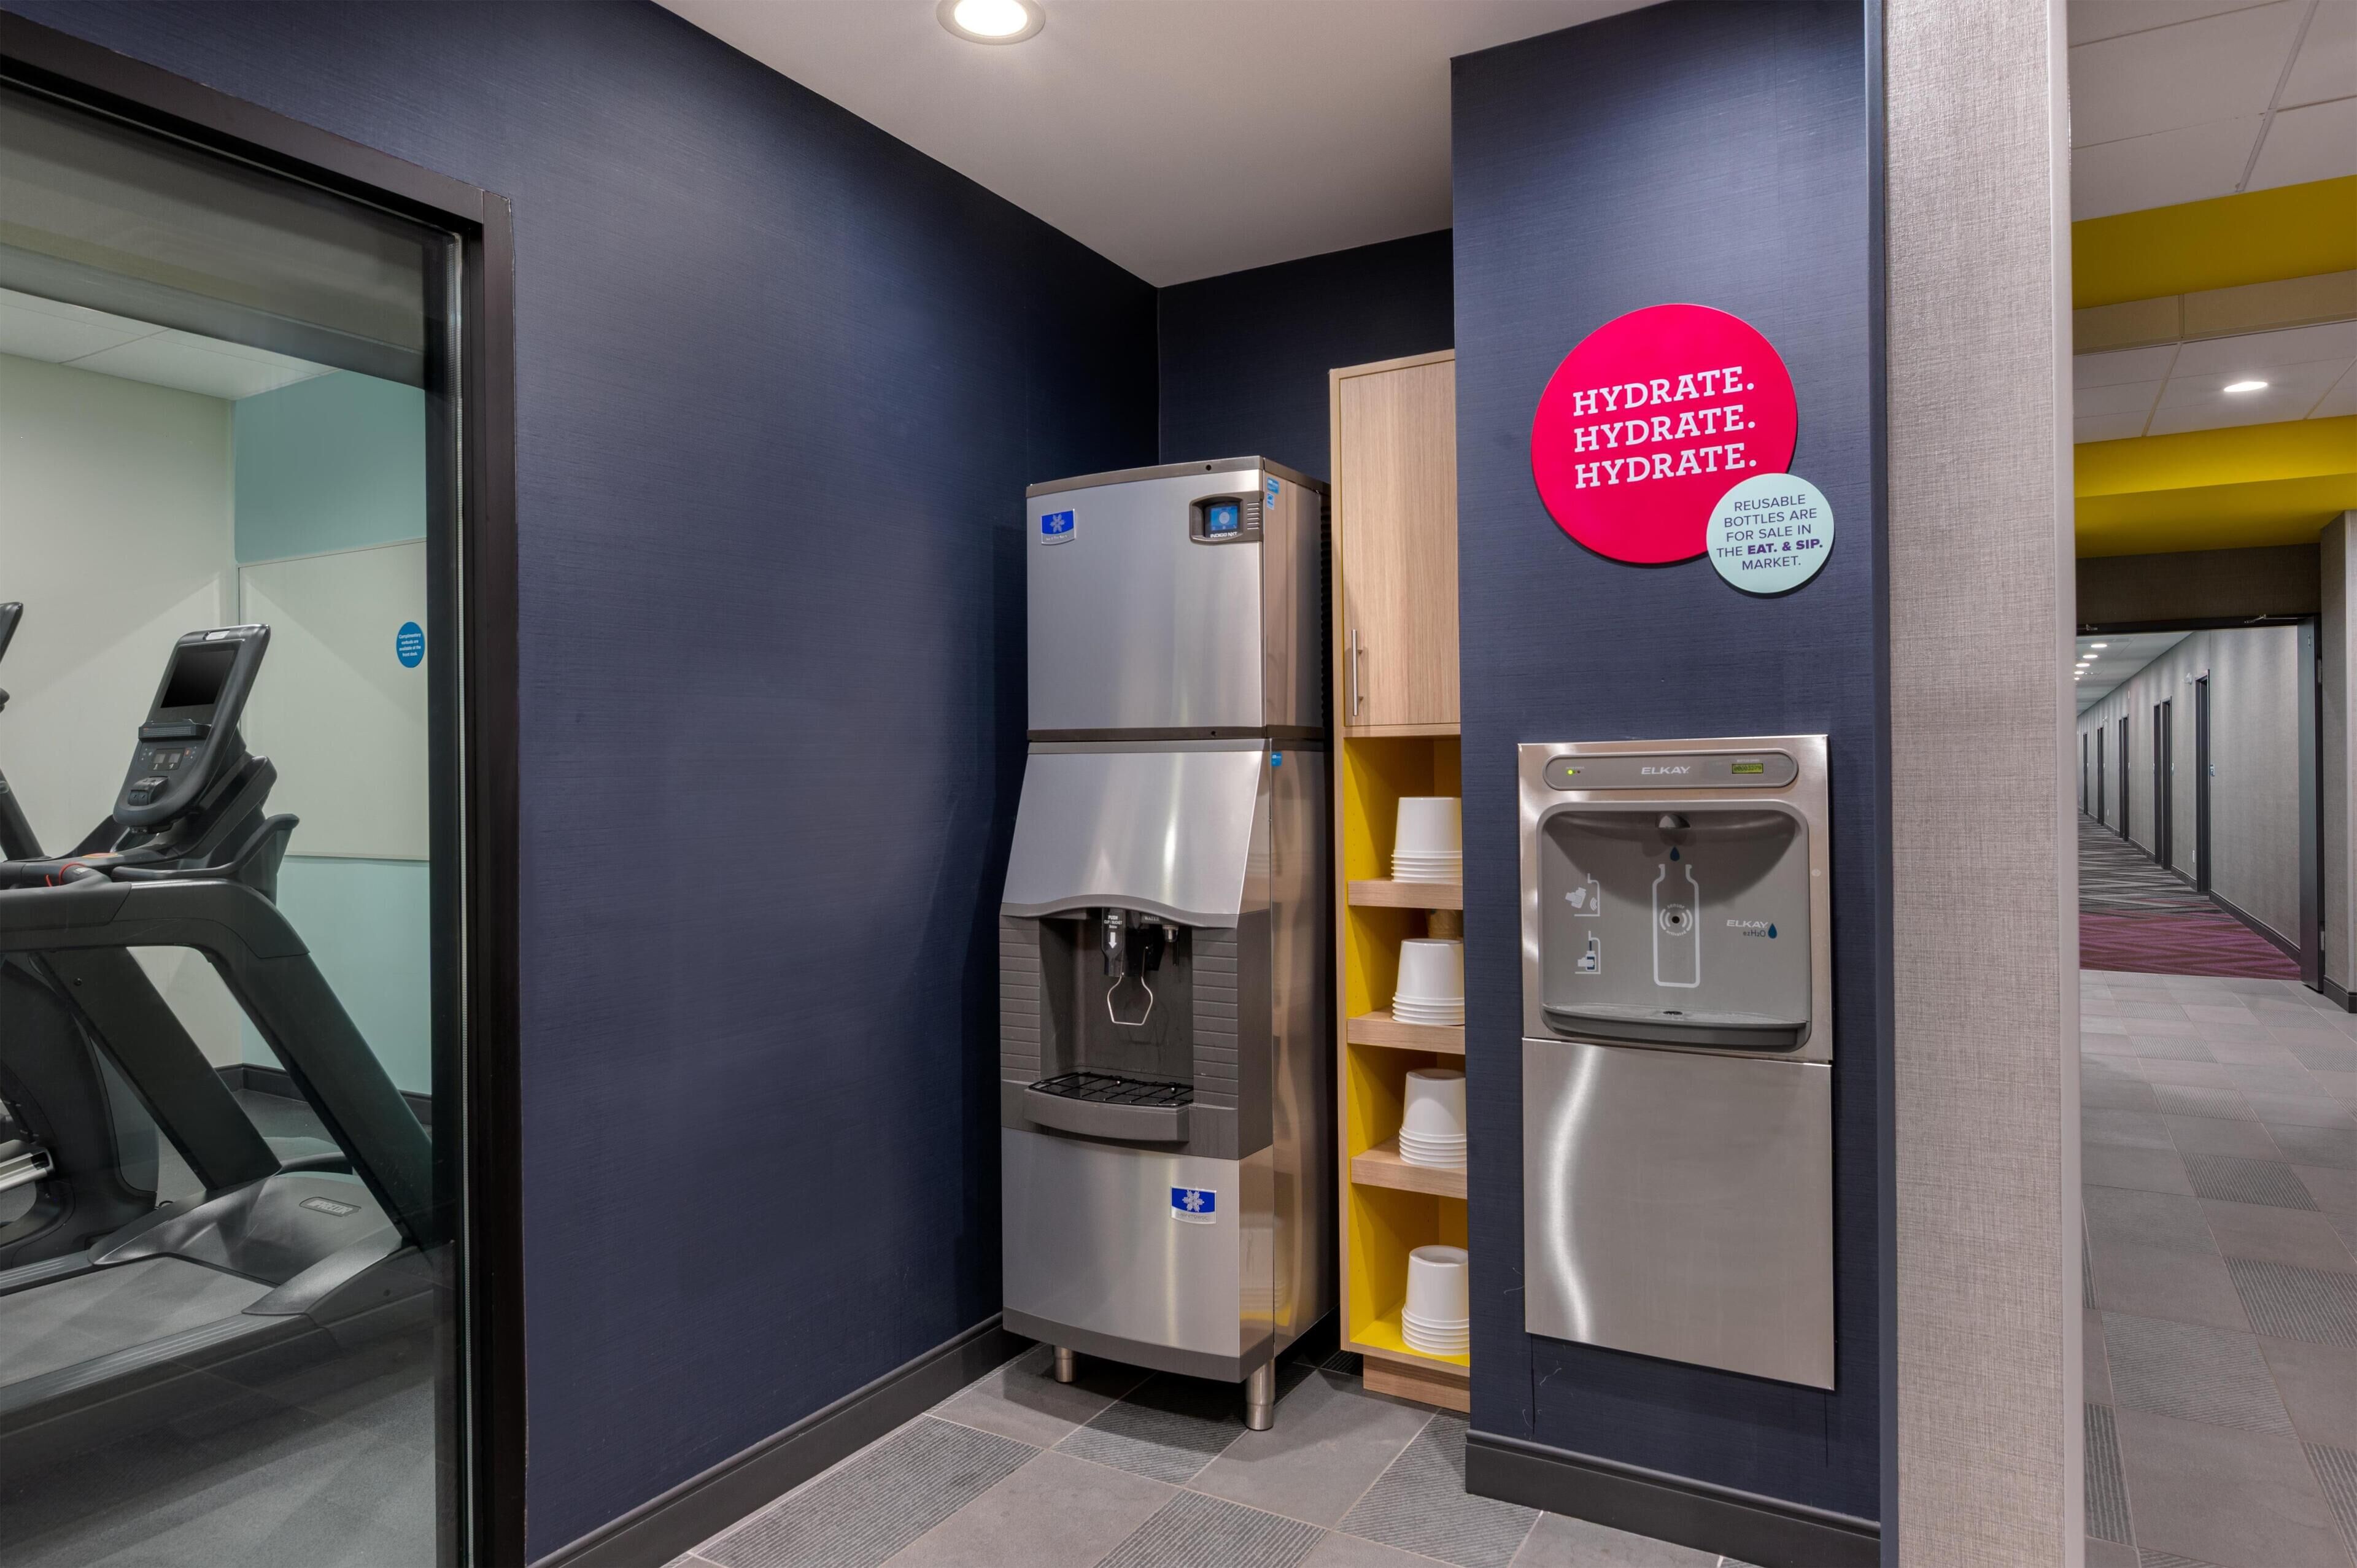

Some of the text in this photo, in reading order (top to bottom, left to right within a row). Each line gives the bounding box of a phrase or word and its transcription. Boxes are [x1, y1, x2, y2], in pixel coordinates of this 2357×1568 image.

[1573, 366, 1754, 416] HYDRATE.
[1574, 404, 1755, 453] HYDRATE.
[1575, 442, 1757, 489] HYDRATE.
[1735, 494, 1806, 512] REUSABLE
[1724, 508, 1817, 528] BOTTLES ARE
[1726, 524, 1811, 542] FOR SALE IN
[1716, 539, 1823, 558] THE EAT. & SIP.
[1742, 555, 1802, 570] MARKET.
[1641, 766, 1690, 774] ELKAY
